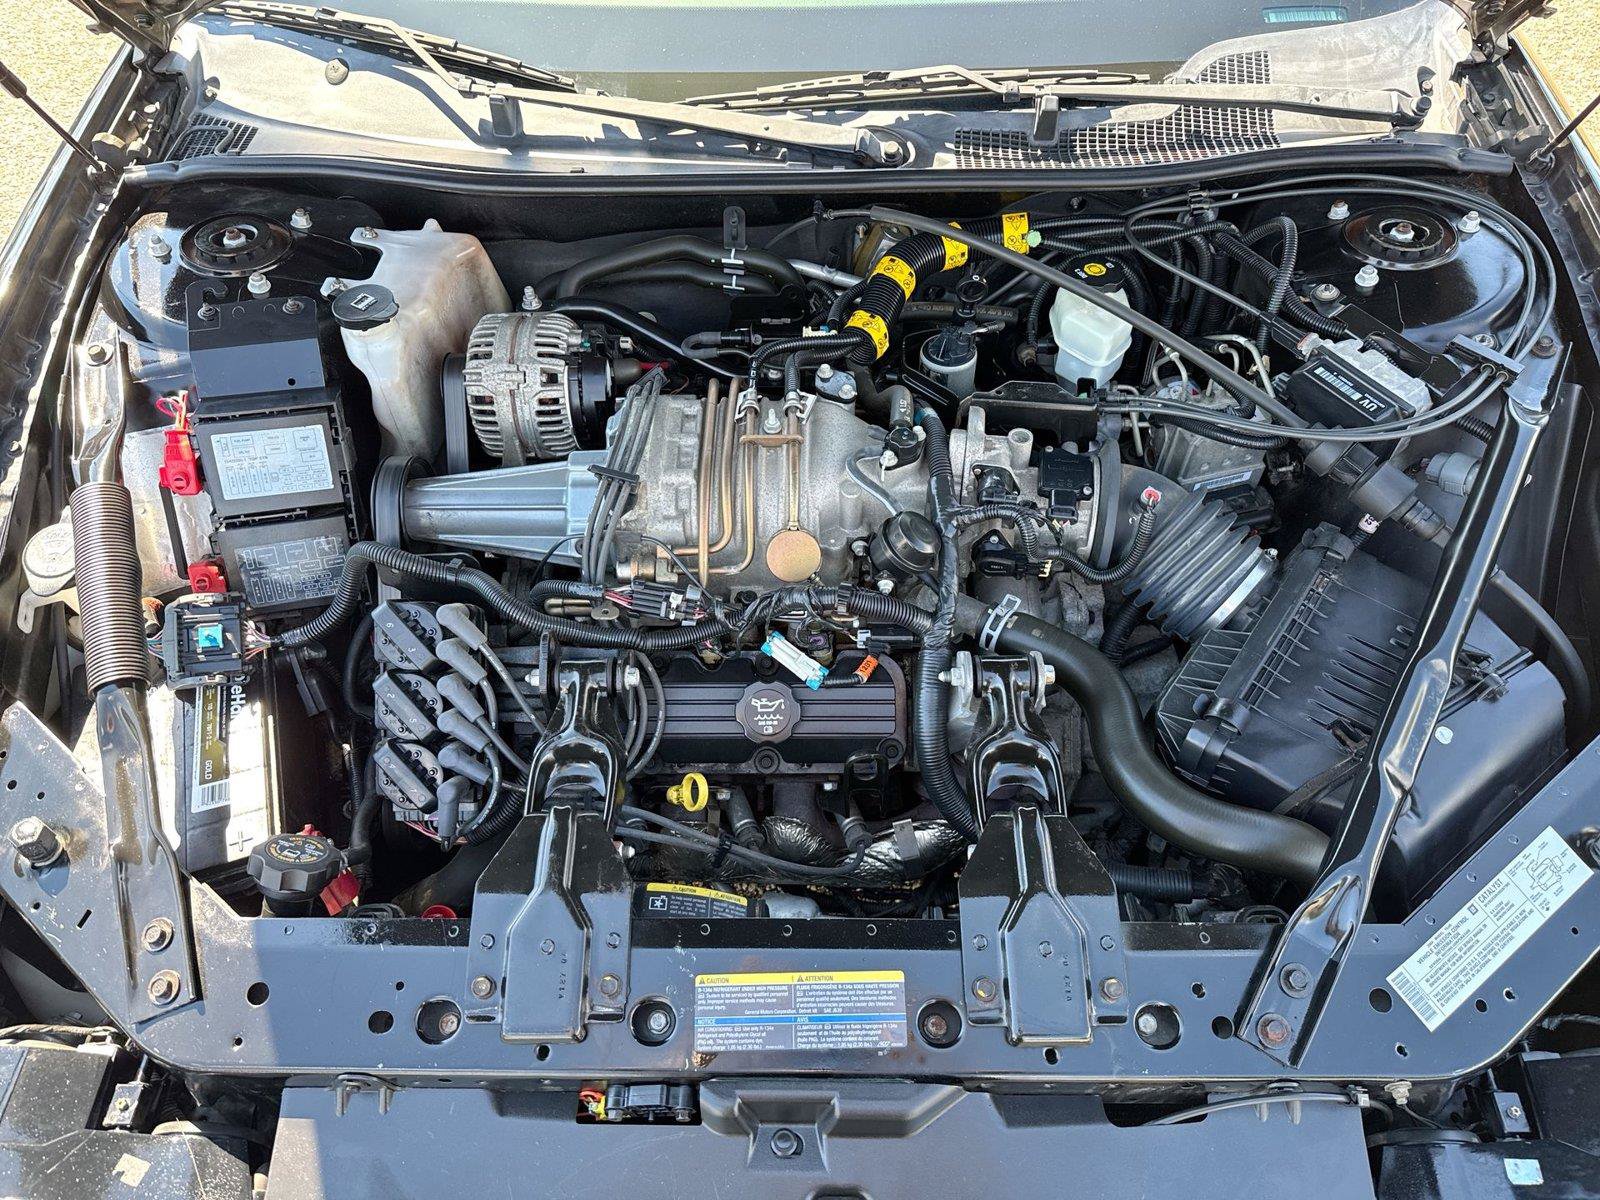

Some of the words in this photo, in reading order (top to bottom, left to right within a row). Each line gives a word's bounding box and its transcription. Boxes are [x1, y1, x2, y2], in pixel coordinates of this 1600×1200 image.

[1358, 399, 1378, 412] UV
[204, 760, 213, 780] GOLD
[1476, 877, 1504, 904] CATALYST
[1416, 947, 1434, 965] VEHICLE
[1432, 930, 1452, 950] EMISSION
[1450, 914, 1469, 933] CONTROL
[1434, 930, 1461, 957] INFORMATION
